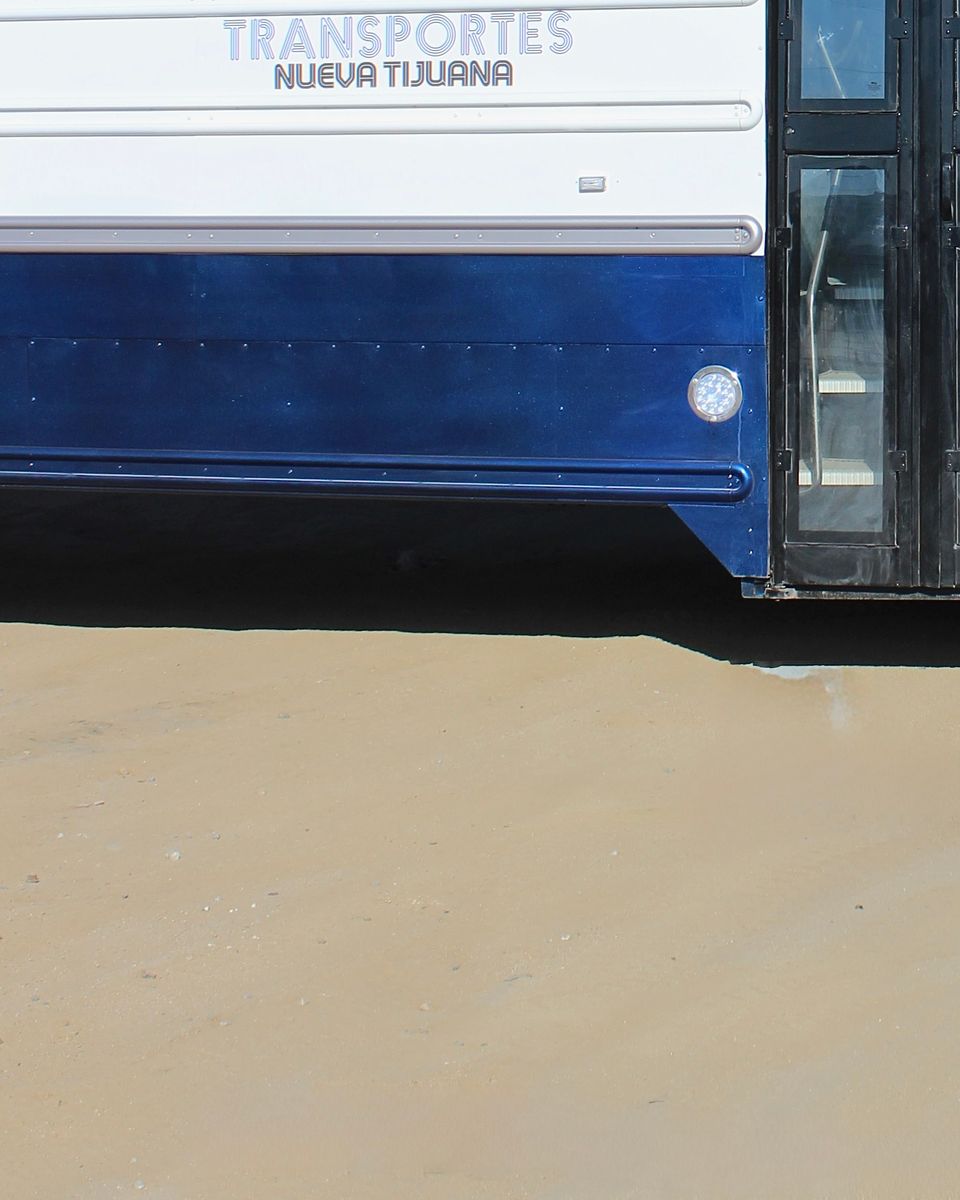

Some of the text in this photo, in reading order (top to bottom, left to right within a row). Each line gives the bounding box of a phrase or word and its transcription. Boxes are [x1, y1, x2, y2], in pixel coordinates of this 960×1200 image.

[223, 10, 574, 61] TRANSPORTES
[274, 59, 514, 90] NUEVA TIJUANA
